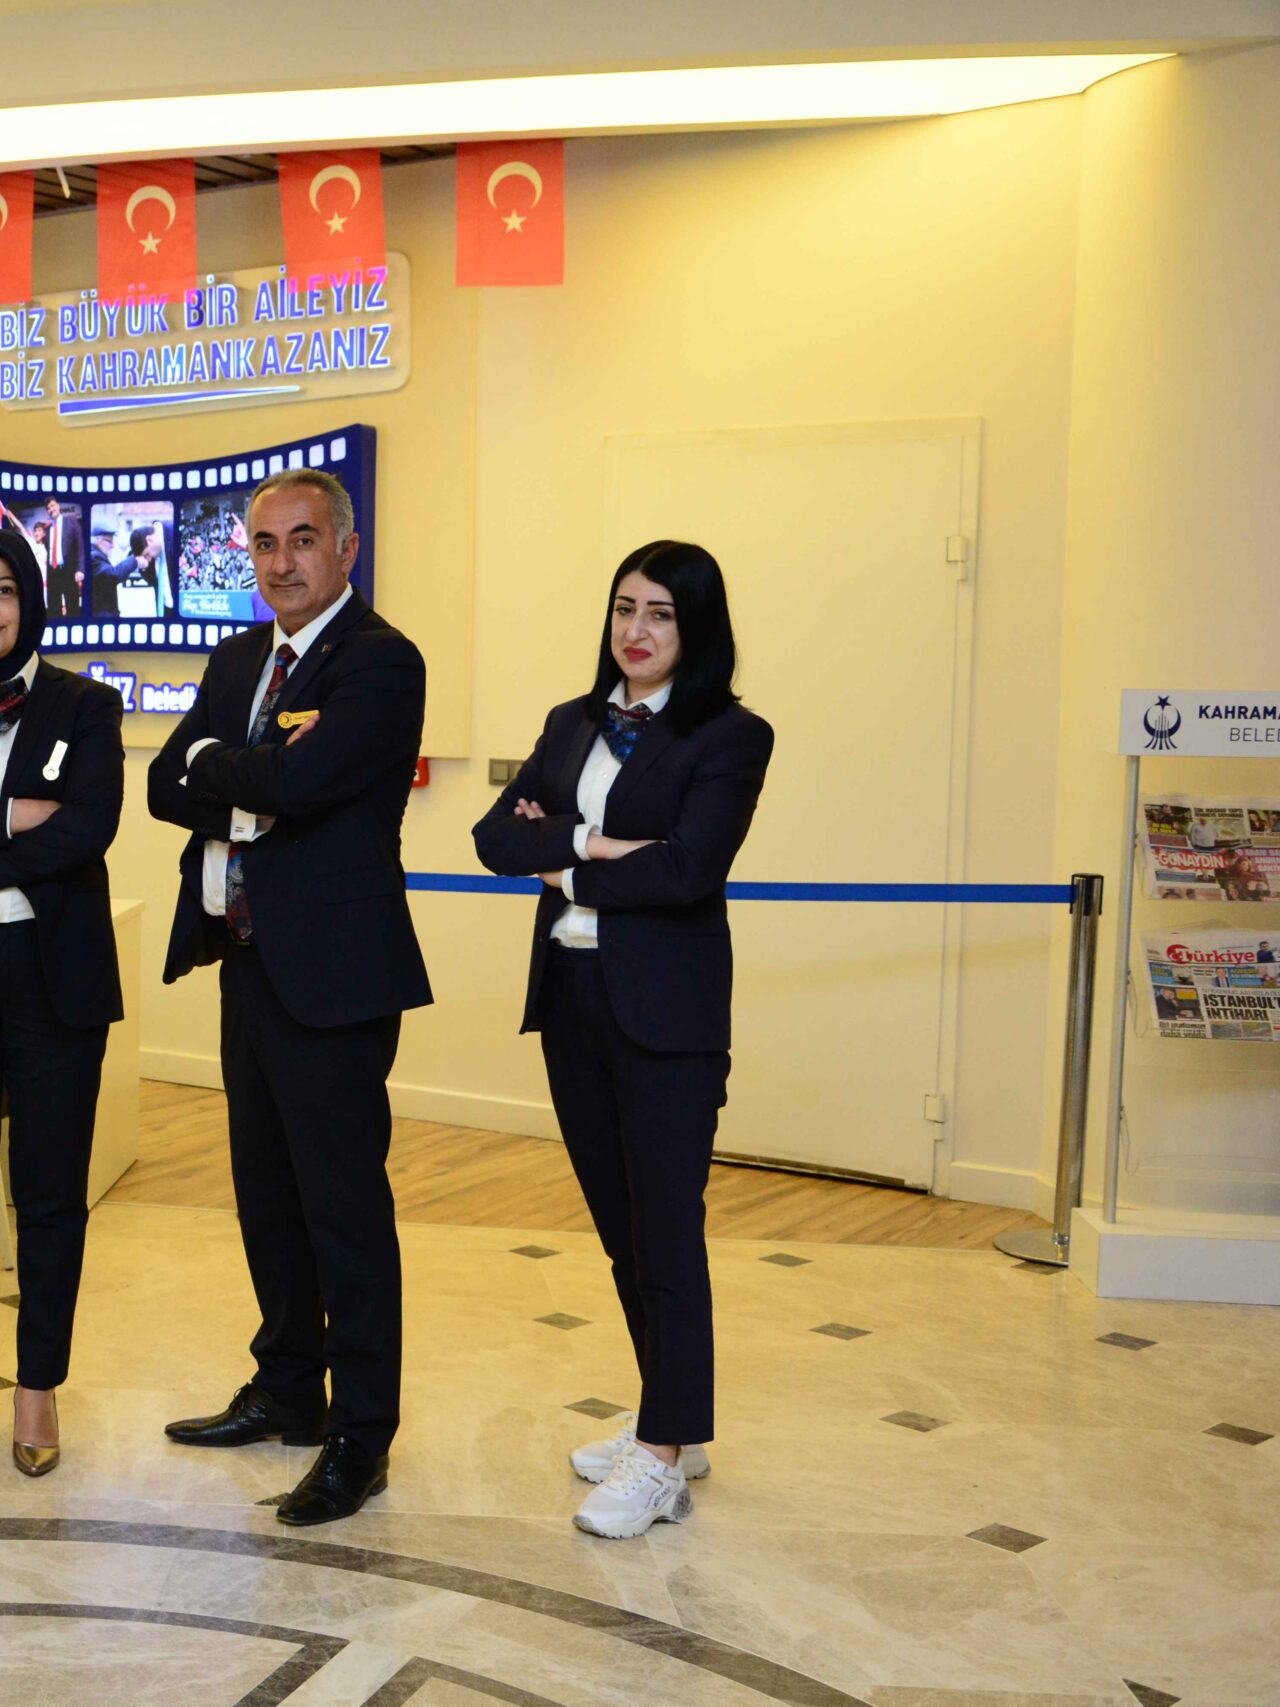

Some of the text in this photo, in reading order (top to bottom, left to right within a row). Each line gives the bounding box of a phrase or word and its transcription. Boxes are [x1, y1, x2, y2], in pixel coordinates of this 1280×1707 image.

[58, 283, 169, 344] BÜYÜK
[184, 275, 238, 329] BİR
[254, 257, 388, 322] AİLEYİZ
[57, 324, 391, 395] KAHRAMANKAZANIZ
[1229, 727, 1280, 742] BELE
